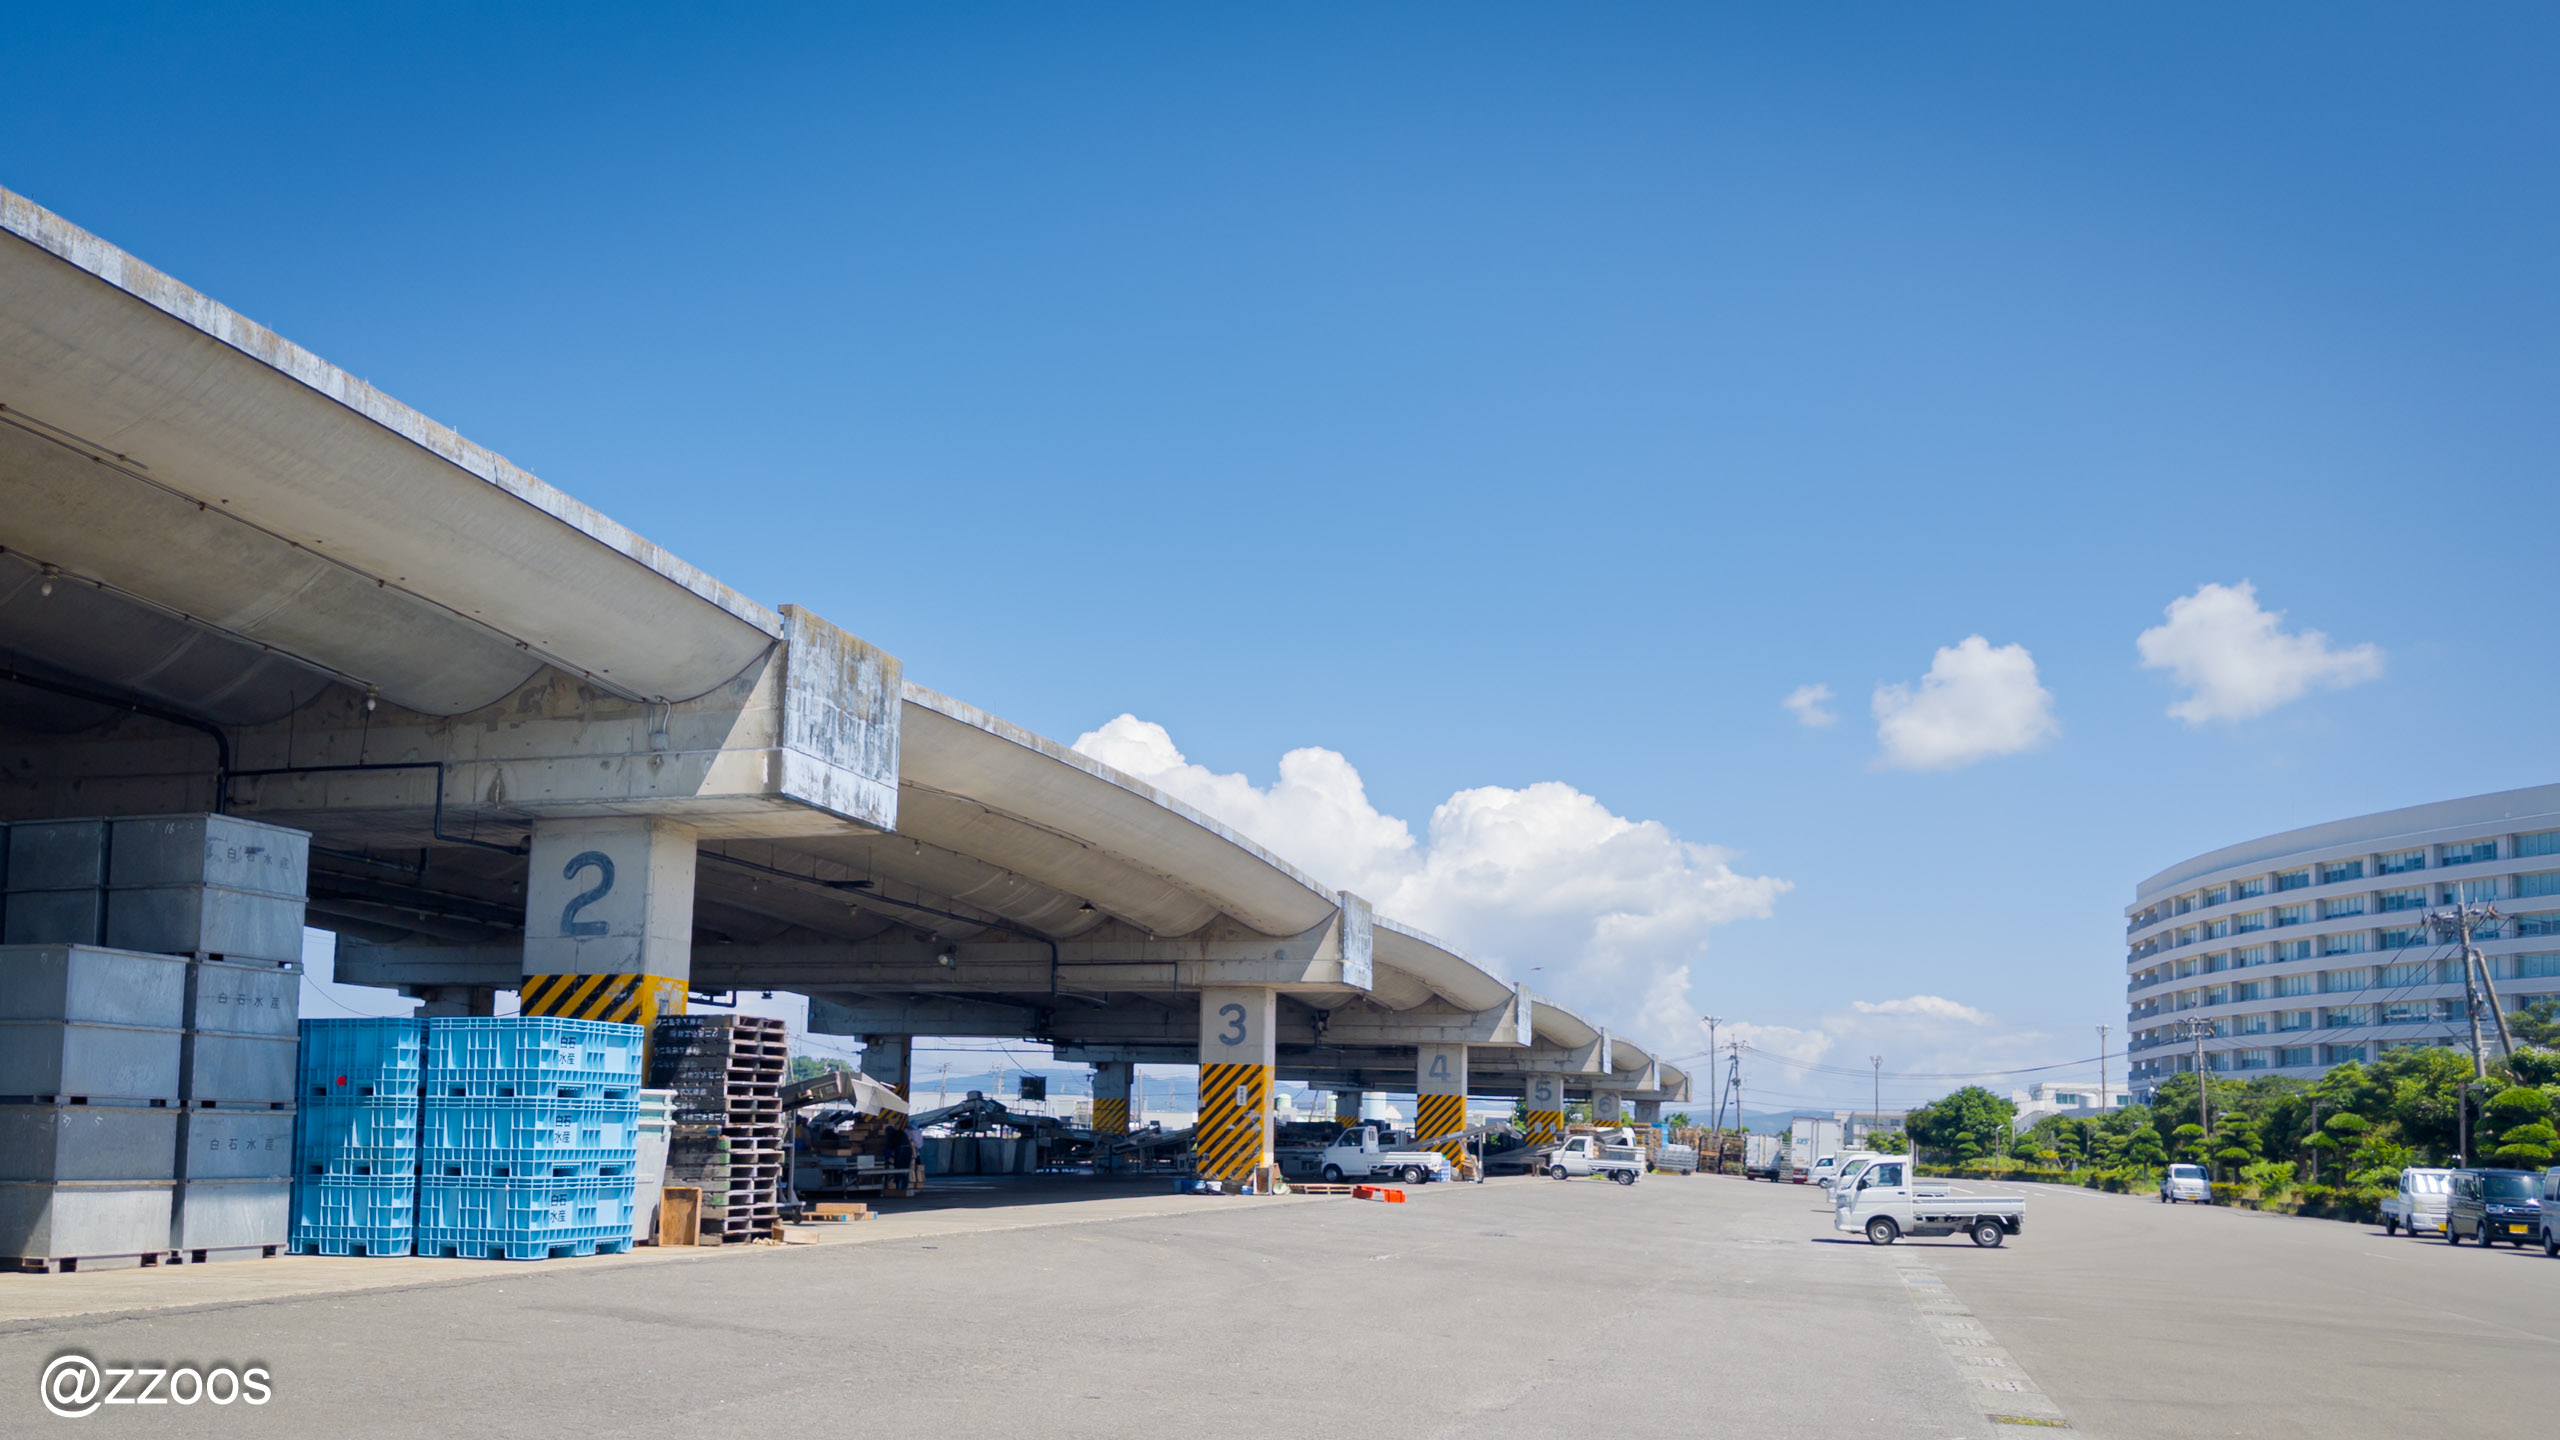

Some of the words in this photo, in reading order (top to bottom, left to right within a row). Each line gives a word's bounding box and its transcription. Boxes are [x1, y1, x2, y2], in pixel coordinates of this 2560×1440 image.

[561, 850, 615, 936] 2
[218, 991, 280, 1009] 白石水産
[1218, 1003, 1246, 1047] 3
[560, 1035, 577, 1048] 白石
[559, 1051, 575, 1065] 水産
[1429, 1054, 1452, 1082] 4
[1535, 1081, 1552, 1101] 5
[1599, 1096, 1612, 1113] 6
[555, 1114, 572, 1127] 白石
[554, 1130, 570, 1144] 水産
[210, 1138, 275, 1151] 白石水産
[551, 1193, 567, 1206] 白石
[550, 1209, 566, 1223] 水産
